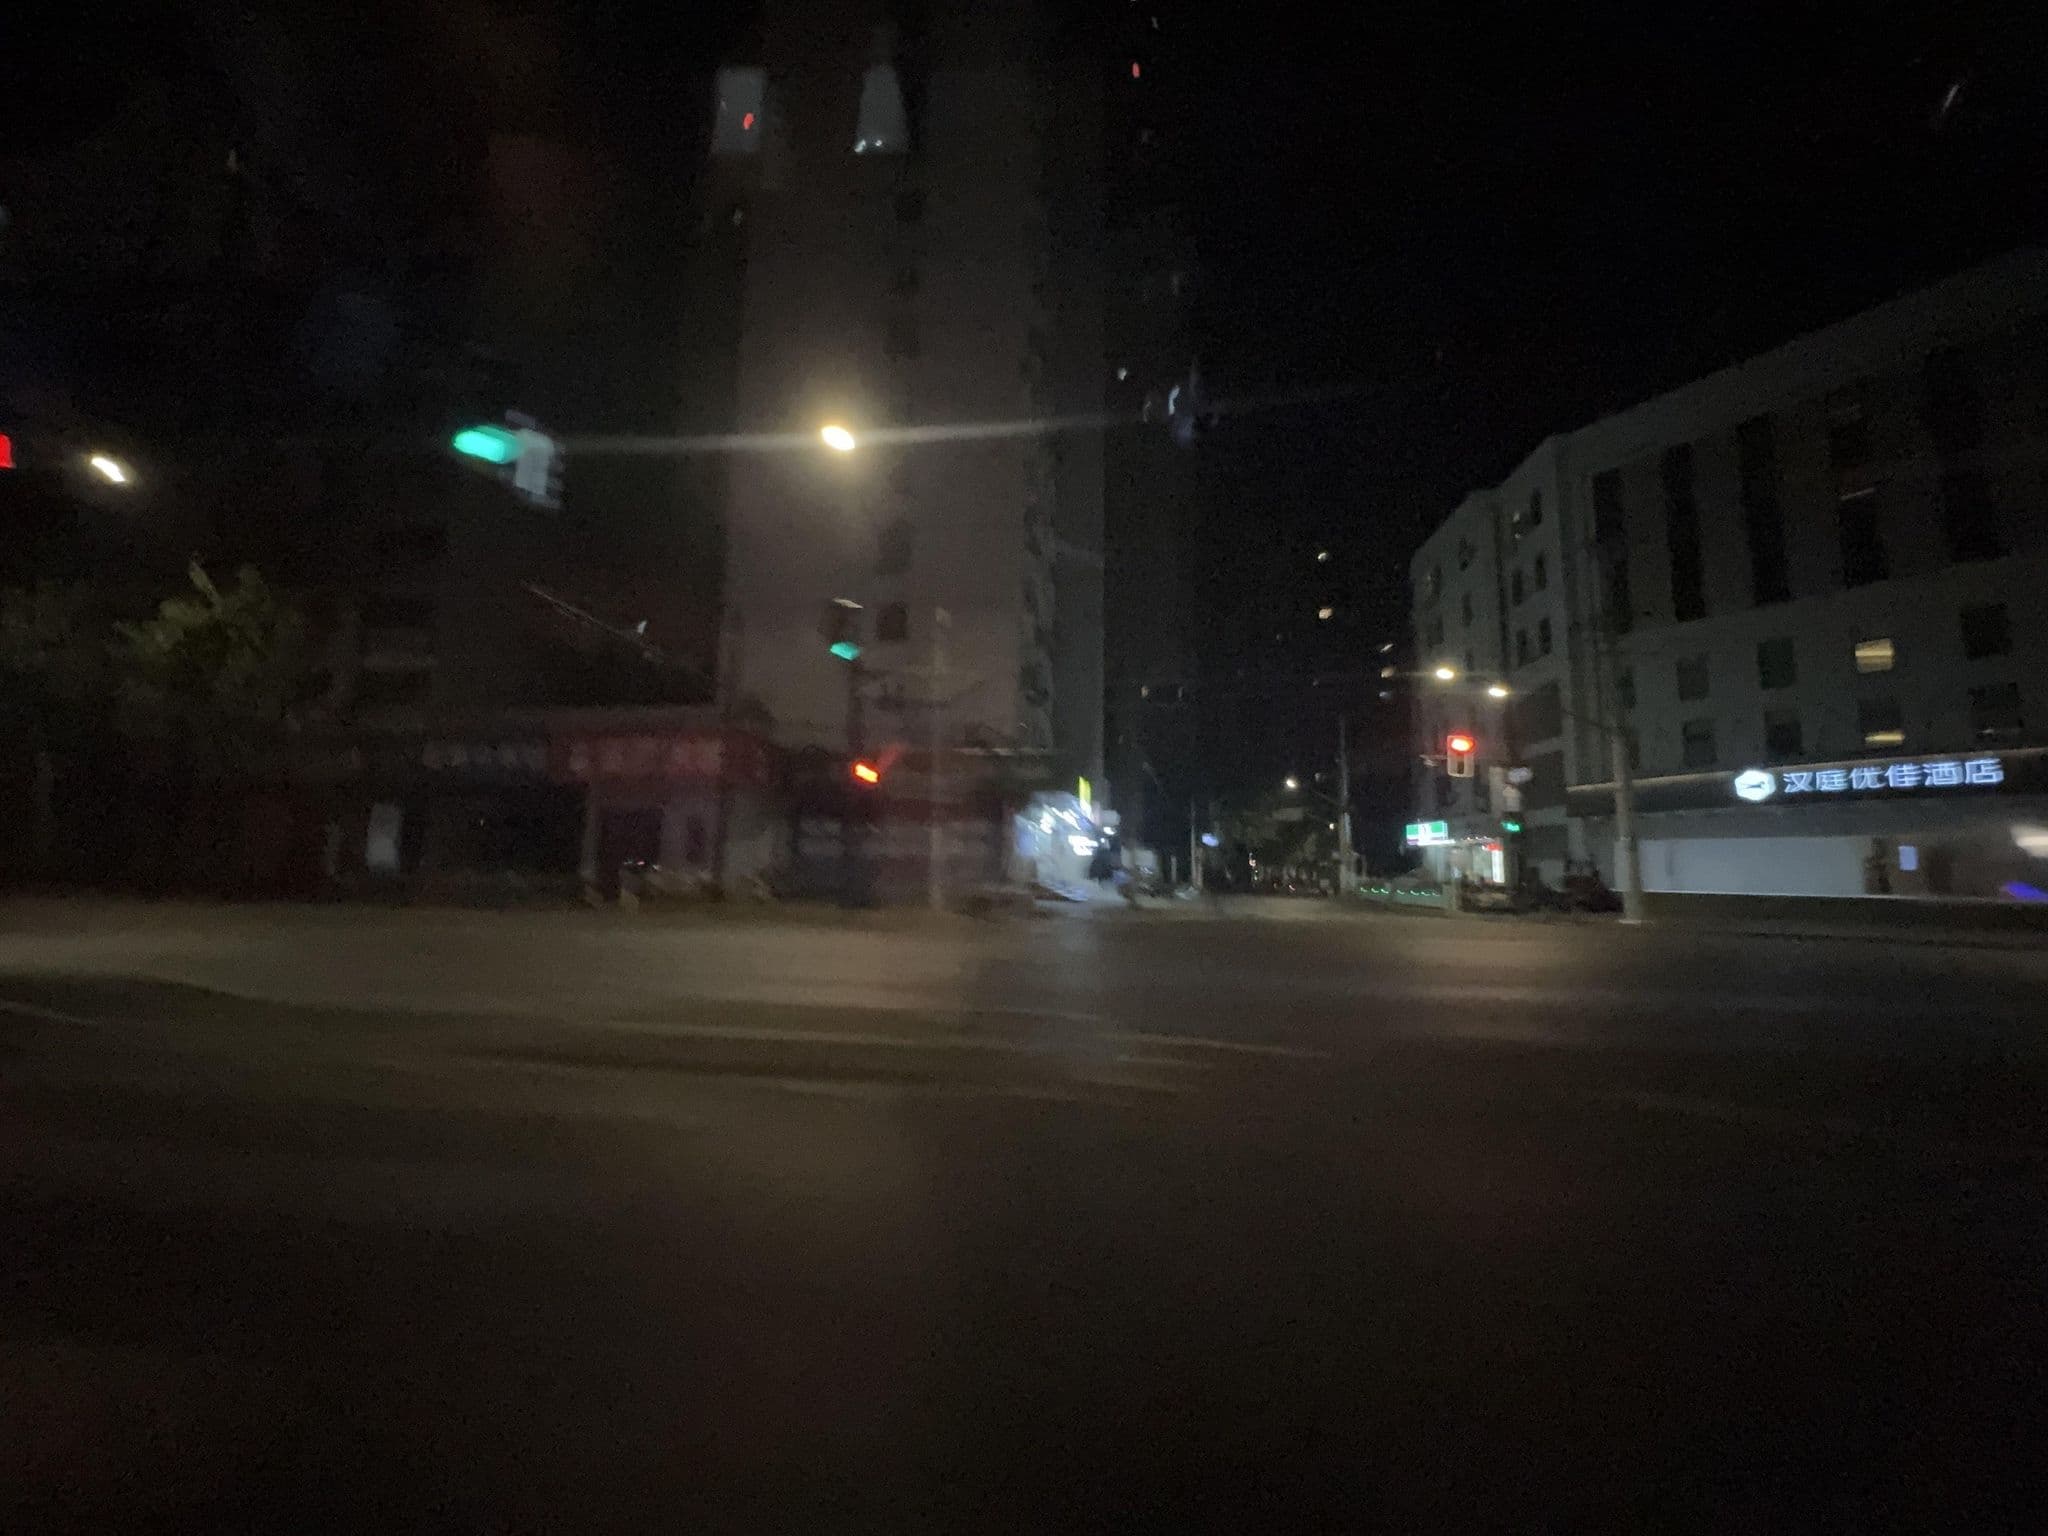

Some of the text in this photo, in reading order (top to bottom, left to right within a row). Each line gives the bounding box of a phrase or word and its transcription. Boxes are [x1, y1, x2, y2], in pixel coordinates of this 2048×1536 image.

[1783, 758, 2004, 793] 汉庭优佳酒店
